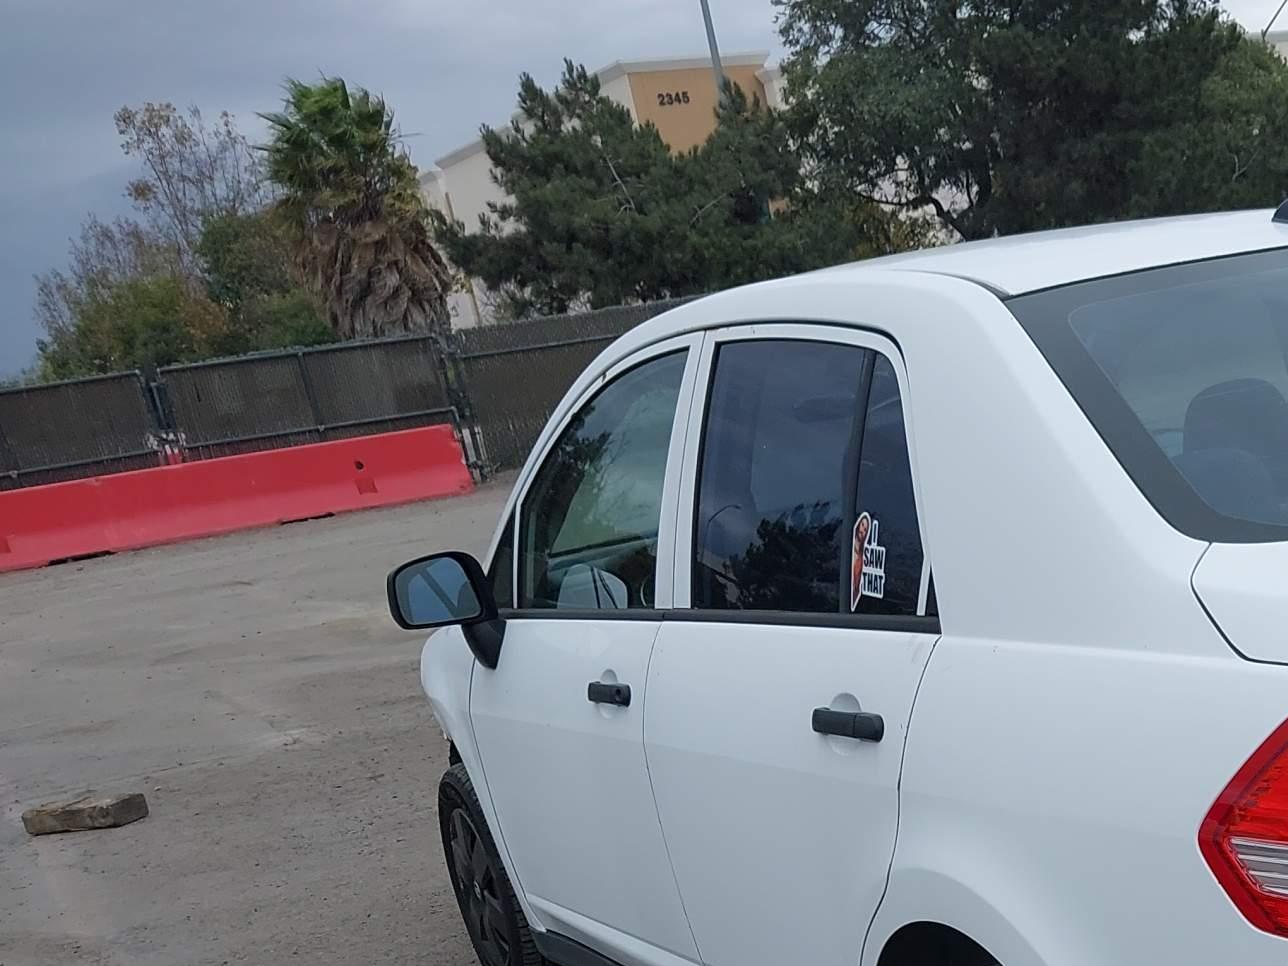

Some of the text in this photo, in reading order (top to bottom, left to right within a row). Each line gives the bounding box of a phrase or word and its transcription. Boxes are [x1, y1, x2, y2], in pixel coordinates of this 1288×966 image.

[657, 91, 690, 106] 2345
[863, 548, 884, 570] SAW
[862, 572, 884, 595] THAT
